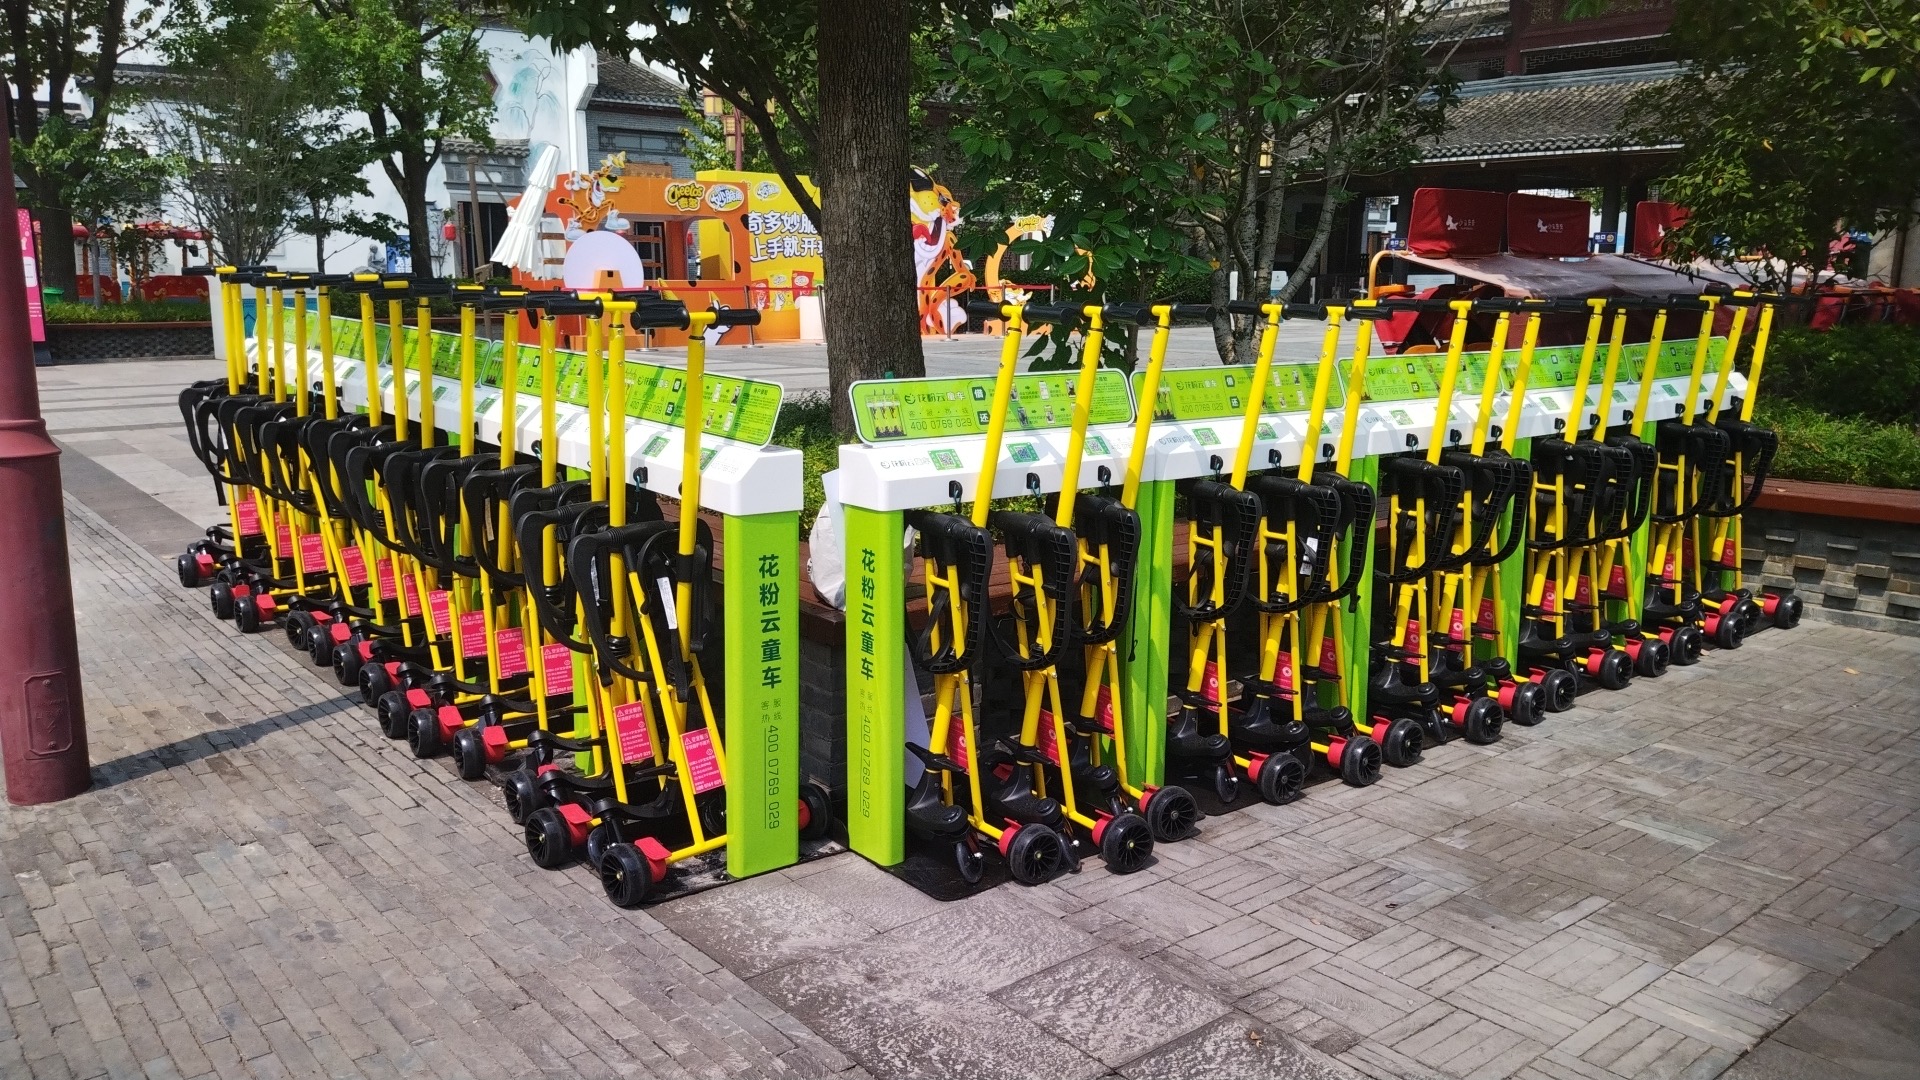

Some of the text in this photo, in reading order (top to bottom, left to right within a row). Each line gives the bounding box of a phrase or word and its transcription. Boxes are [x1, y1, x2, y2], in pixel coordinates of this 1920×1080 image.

[668, 183, 704, 204] Cheetos
[910, 417, 973, 431] 400 0769 029
[917, 391, 966, 403] 花粉云童车
[758, 554, 782, 690] 花粉云童车
[860, 548, 875, 681] 花粉云童车
[767, 725, 780, 830] 400 0769 029
[861, 715, 871, 818] 400 0769 029
